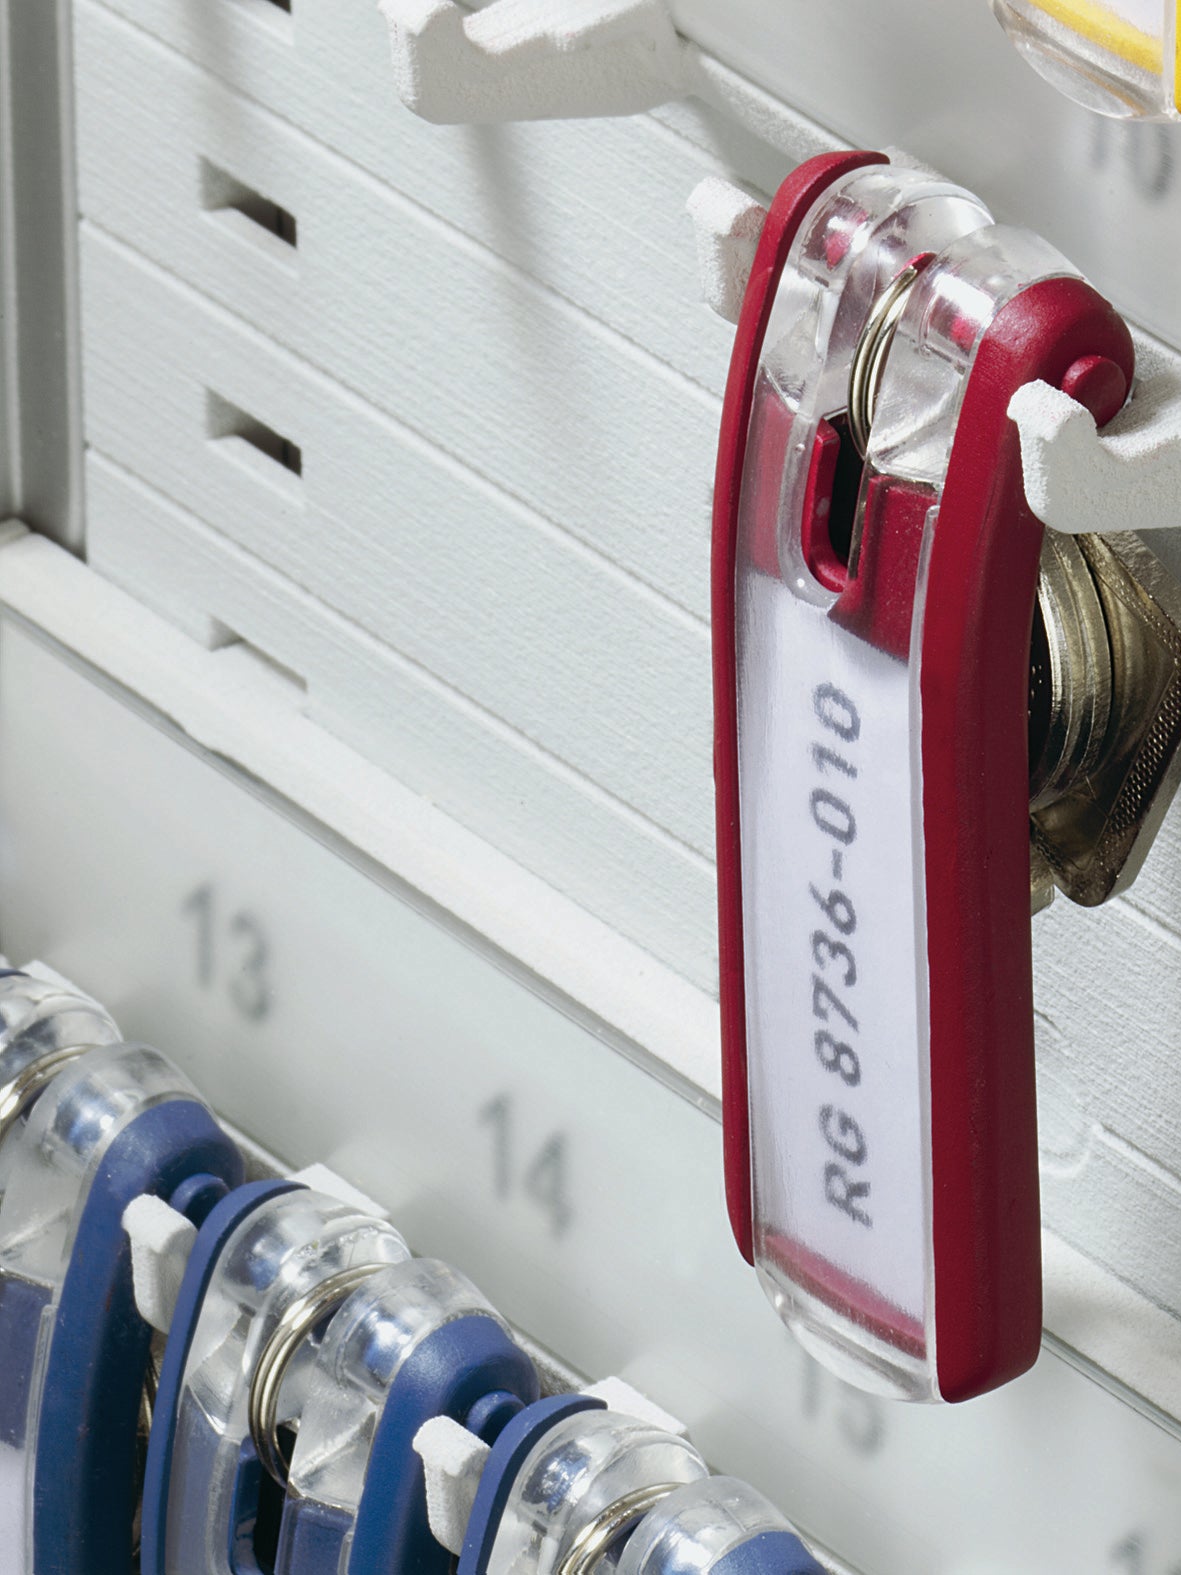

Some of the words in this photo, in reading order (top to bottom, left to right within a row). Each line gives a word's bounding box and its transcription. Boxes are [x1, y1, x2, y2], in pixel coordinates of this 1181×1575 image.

[181, 880, 271, 1024] 13
[808, 681, 861, 1088] 8736-010
[480, 1092, 572, 1241] 14
[819, 1103, 872, 1228] RG
